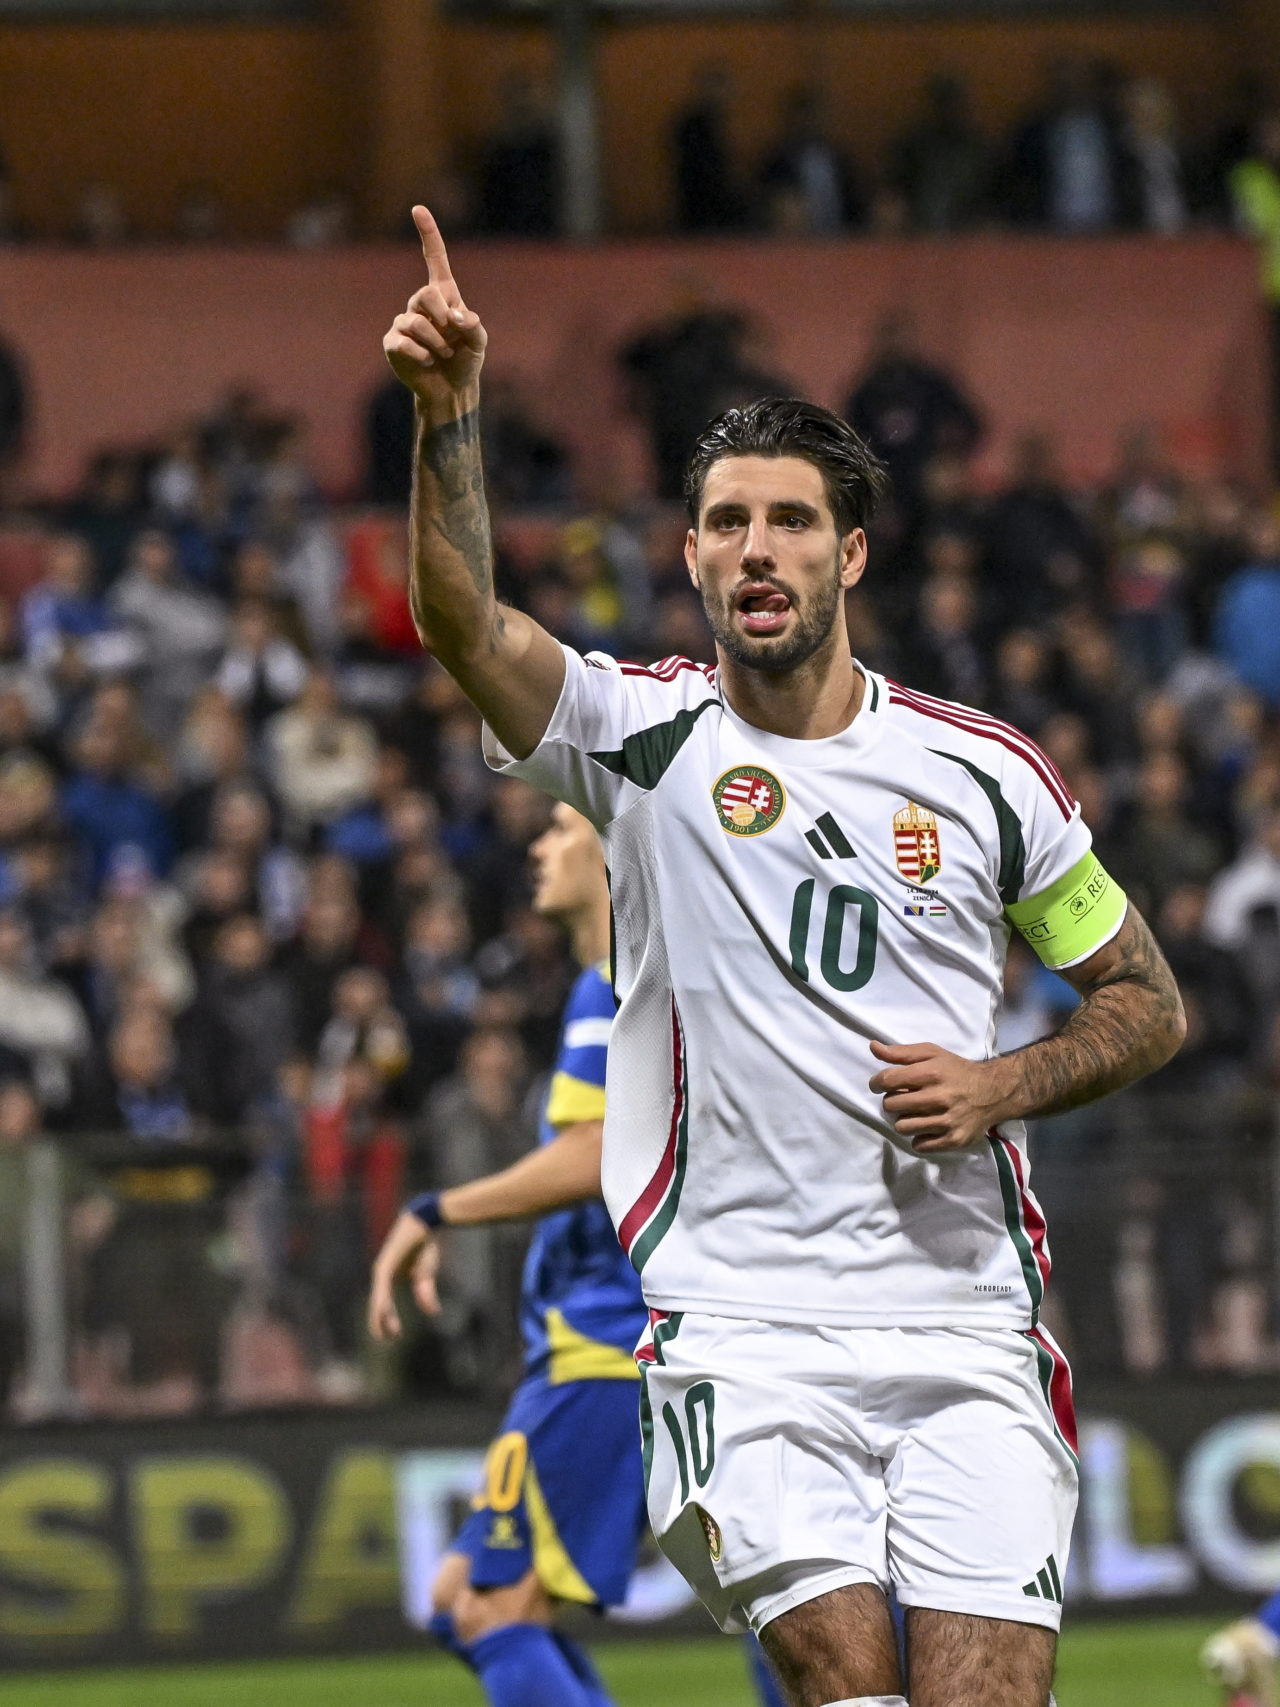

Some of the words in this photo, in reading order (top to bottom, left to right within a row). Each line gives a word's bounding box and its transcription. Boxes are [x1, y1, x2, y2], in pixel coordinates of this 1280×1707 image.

[789, 878, 878, 992] 10
[1021, 921, 1050, 939] ECT
[974, 1285, 1012, 1293] AEROREADY
[662, 1381, 715, 1506] 10
